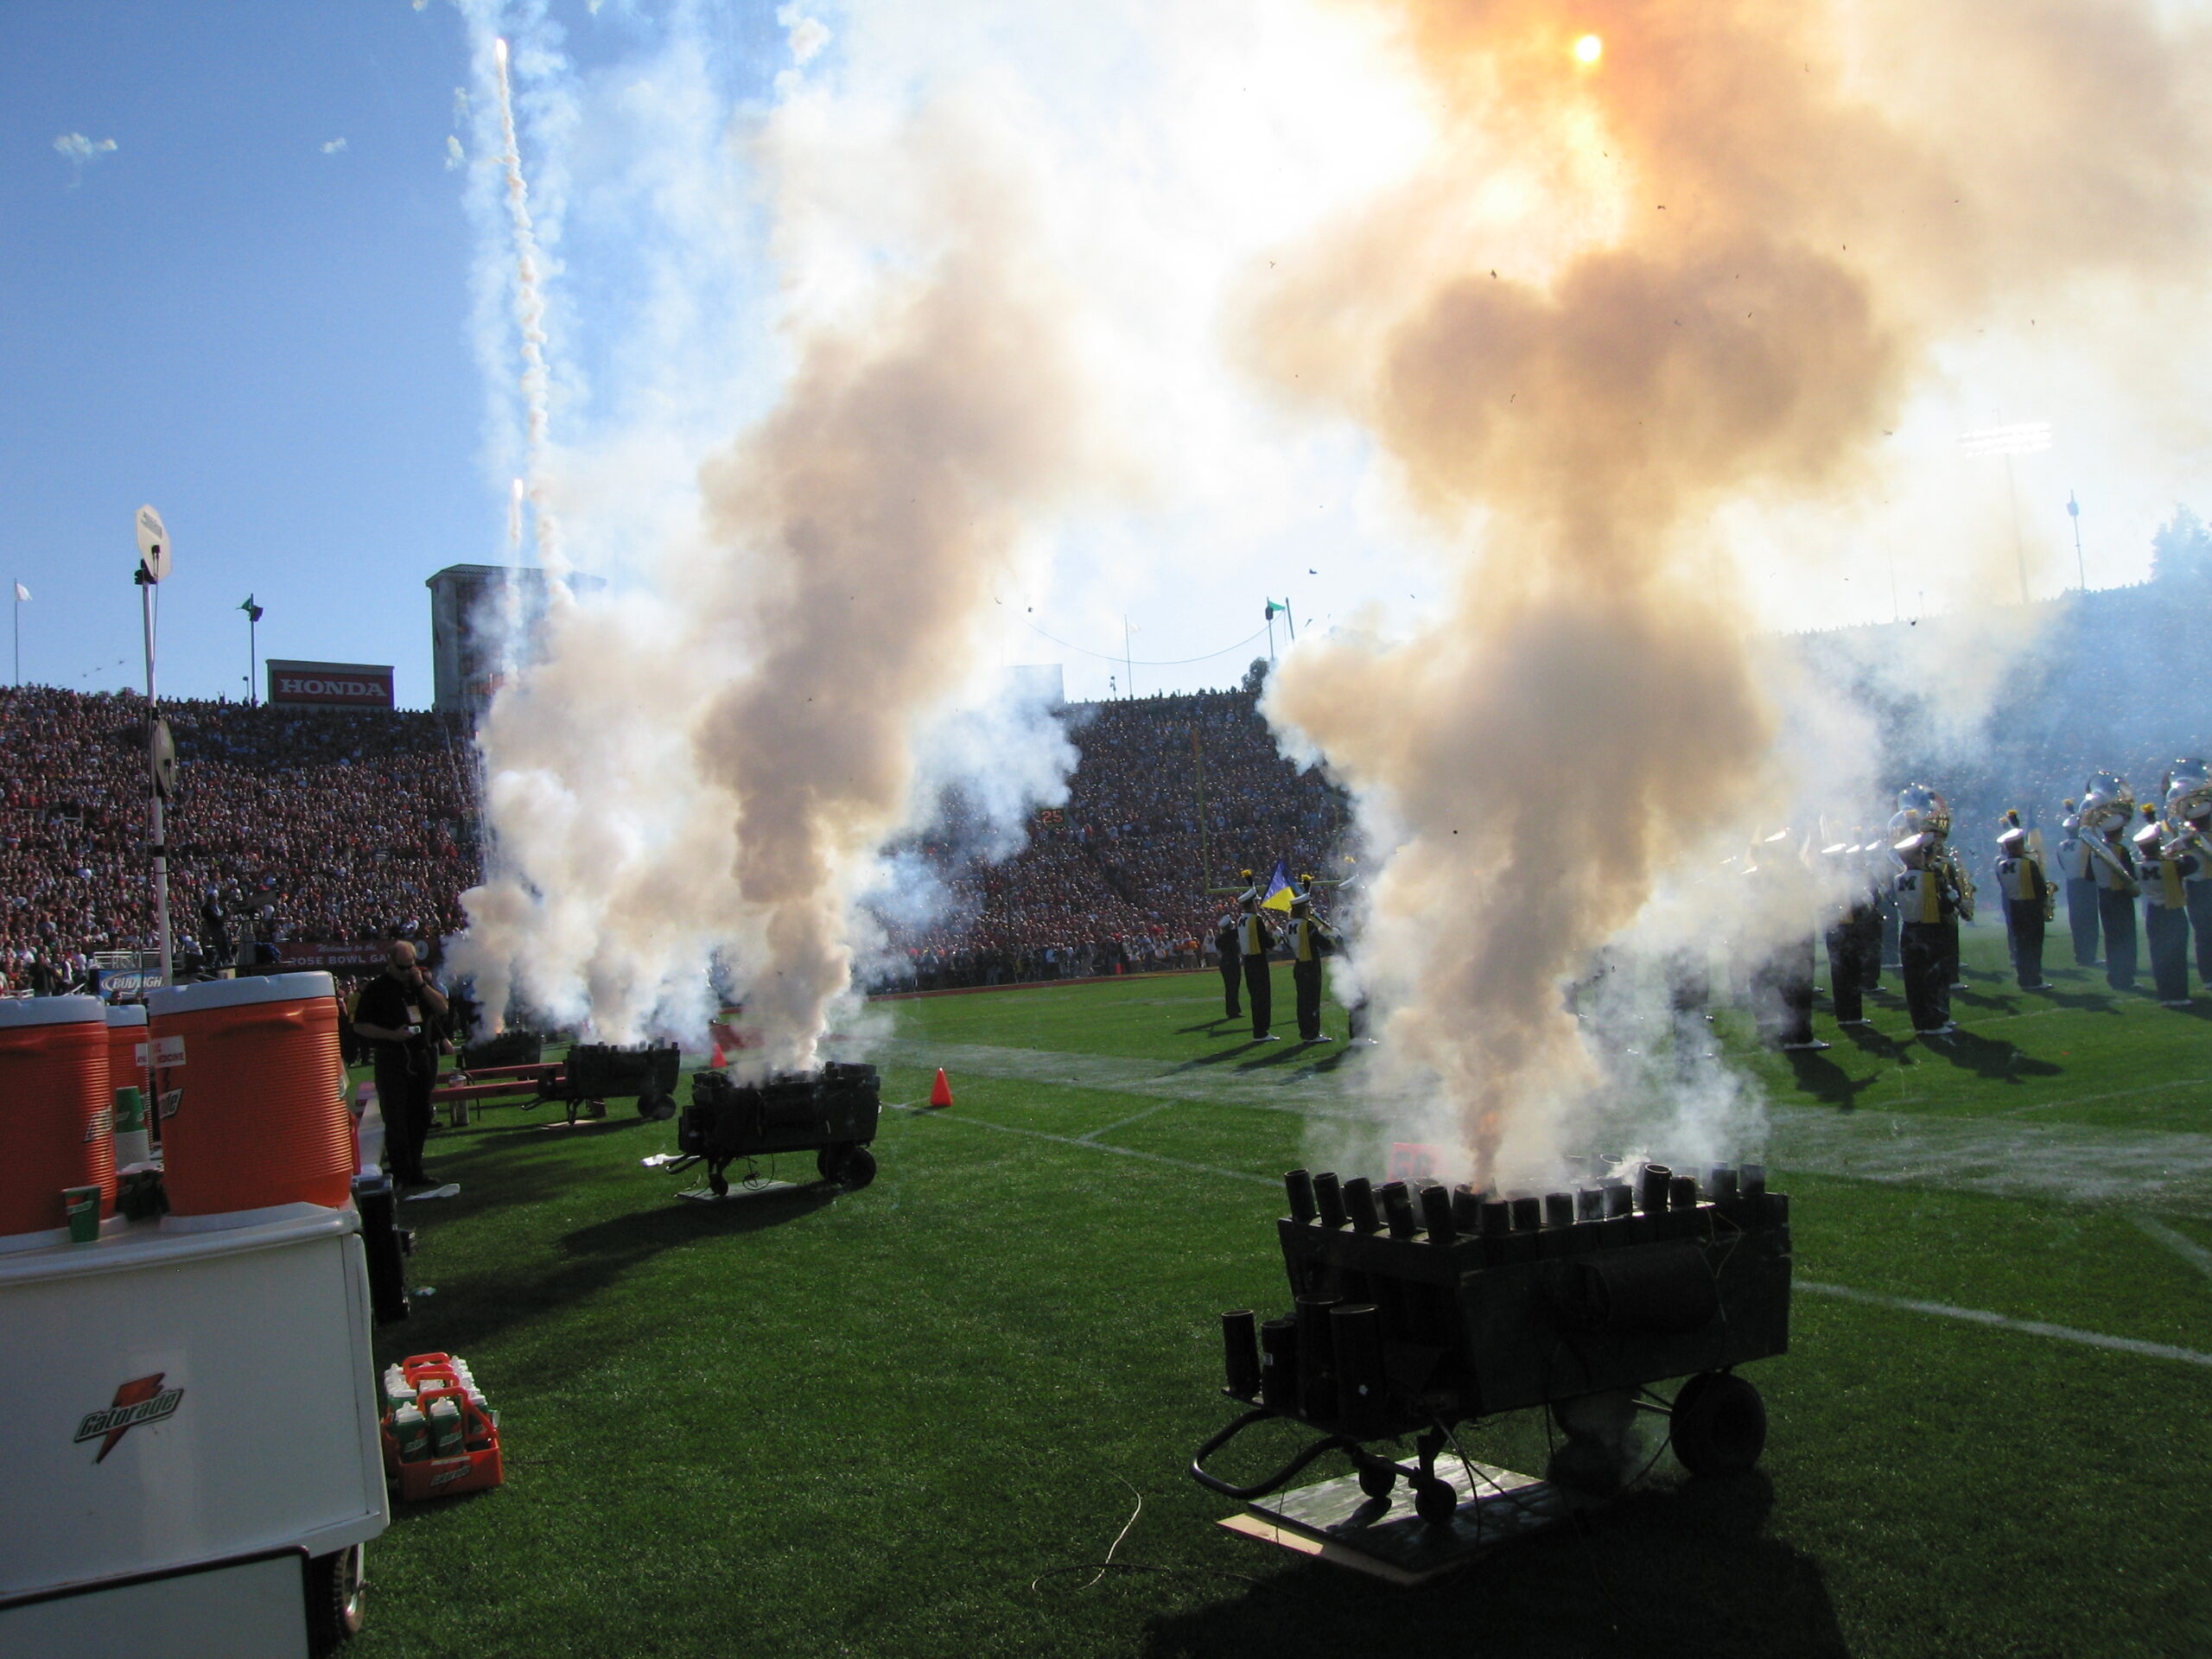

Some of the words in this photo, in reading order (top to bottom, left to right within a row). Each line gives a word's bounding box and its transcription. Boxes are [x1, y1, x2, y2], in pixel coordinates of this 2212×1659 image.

[280, 678, 387, 696] HONDA
[1041, 810, 1064, 823] 25
[2001, 861, 2017, 874] M
[2140, 866, 2161, 881] M
[1897, 875, 1917, 892] M
[1287, 923, 1300, 936] M
[289, 956, 324, 966] ROSE
[327, 954, 367, 965] BOWL
[369, 953, 391, 963] GA
[79, 1391, 179, 1437] Gatorade
